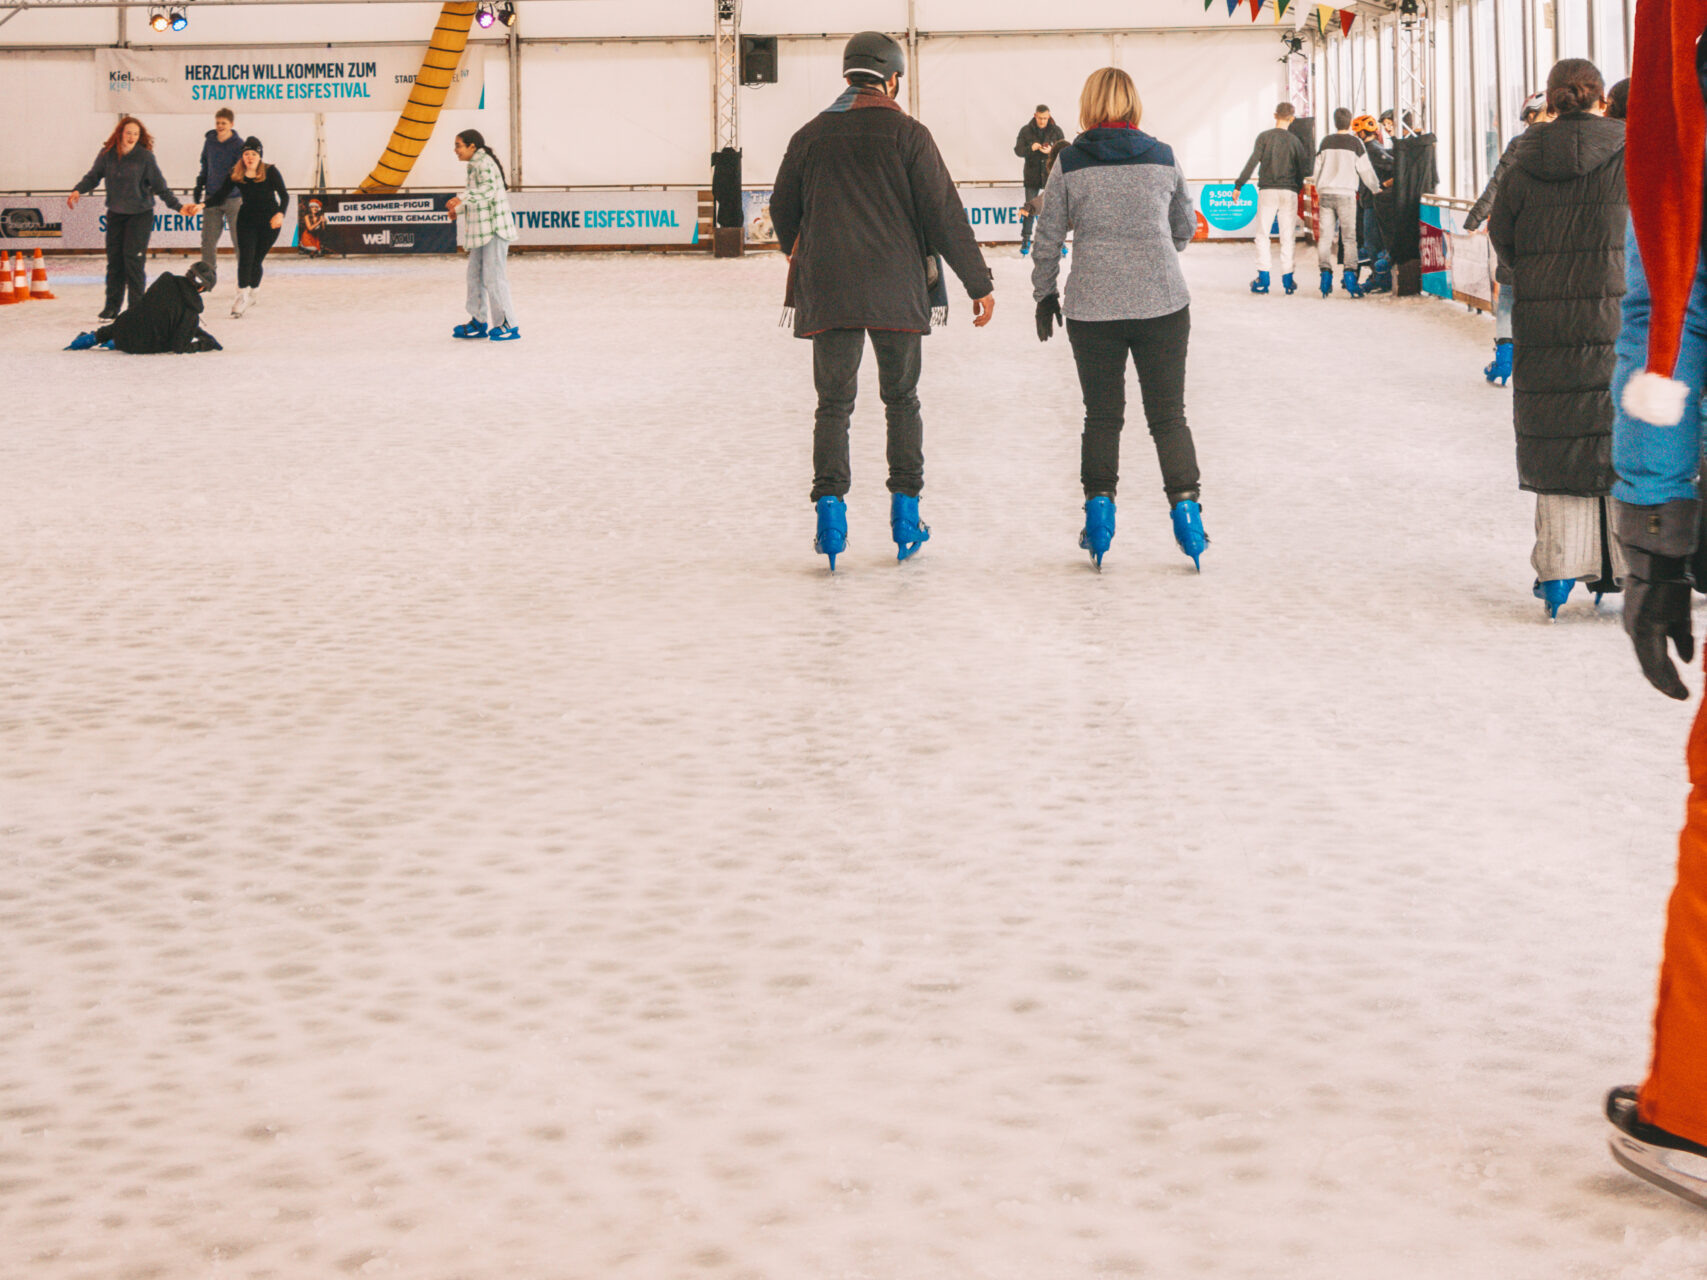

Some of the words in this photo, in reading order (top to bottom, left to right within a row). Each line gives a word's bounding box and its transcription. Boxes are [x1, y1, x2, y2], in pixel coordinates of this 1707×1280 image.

[185, 64, 249, 80] HERZLICH
[253, 62, 344, 79] WILLKOMMEN
[348, 61, 377, 77] ZUM
[394, 74, 417, 84] STADT
[192, 83, 283, 100] STADTWERKE
[286, 81, 371, 99] EISFESTIVAL
[343, 203, 358, 211] DIE
[360, 200, 430, 211] SOMMER-FIGUR
[328, 214, 353, 223] WIRD
[355, 214, 367, 222] IM
[368, 213, 403, 223] WINTER
[405, 213, 449, 222] GEMACHT
[584, 209, 679, 228] EISFESTIVAL
